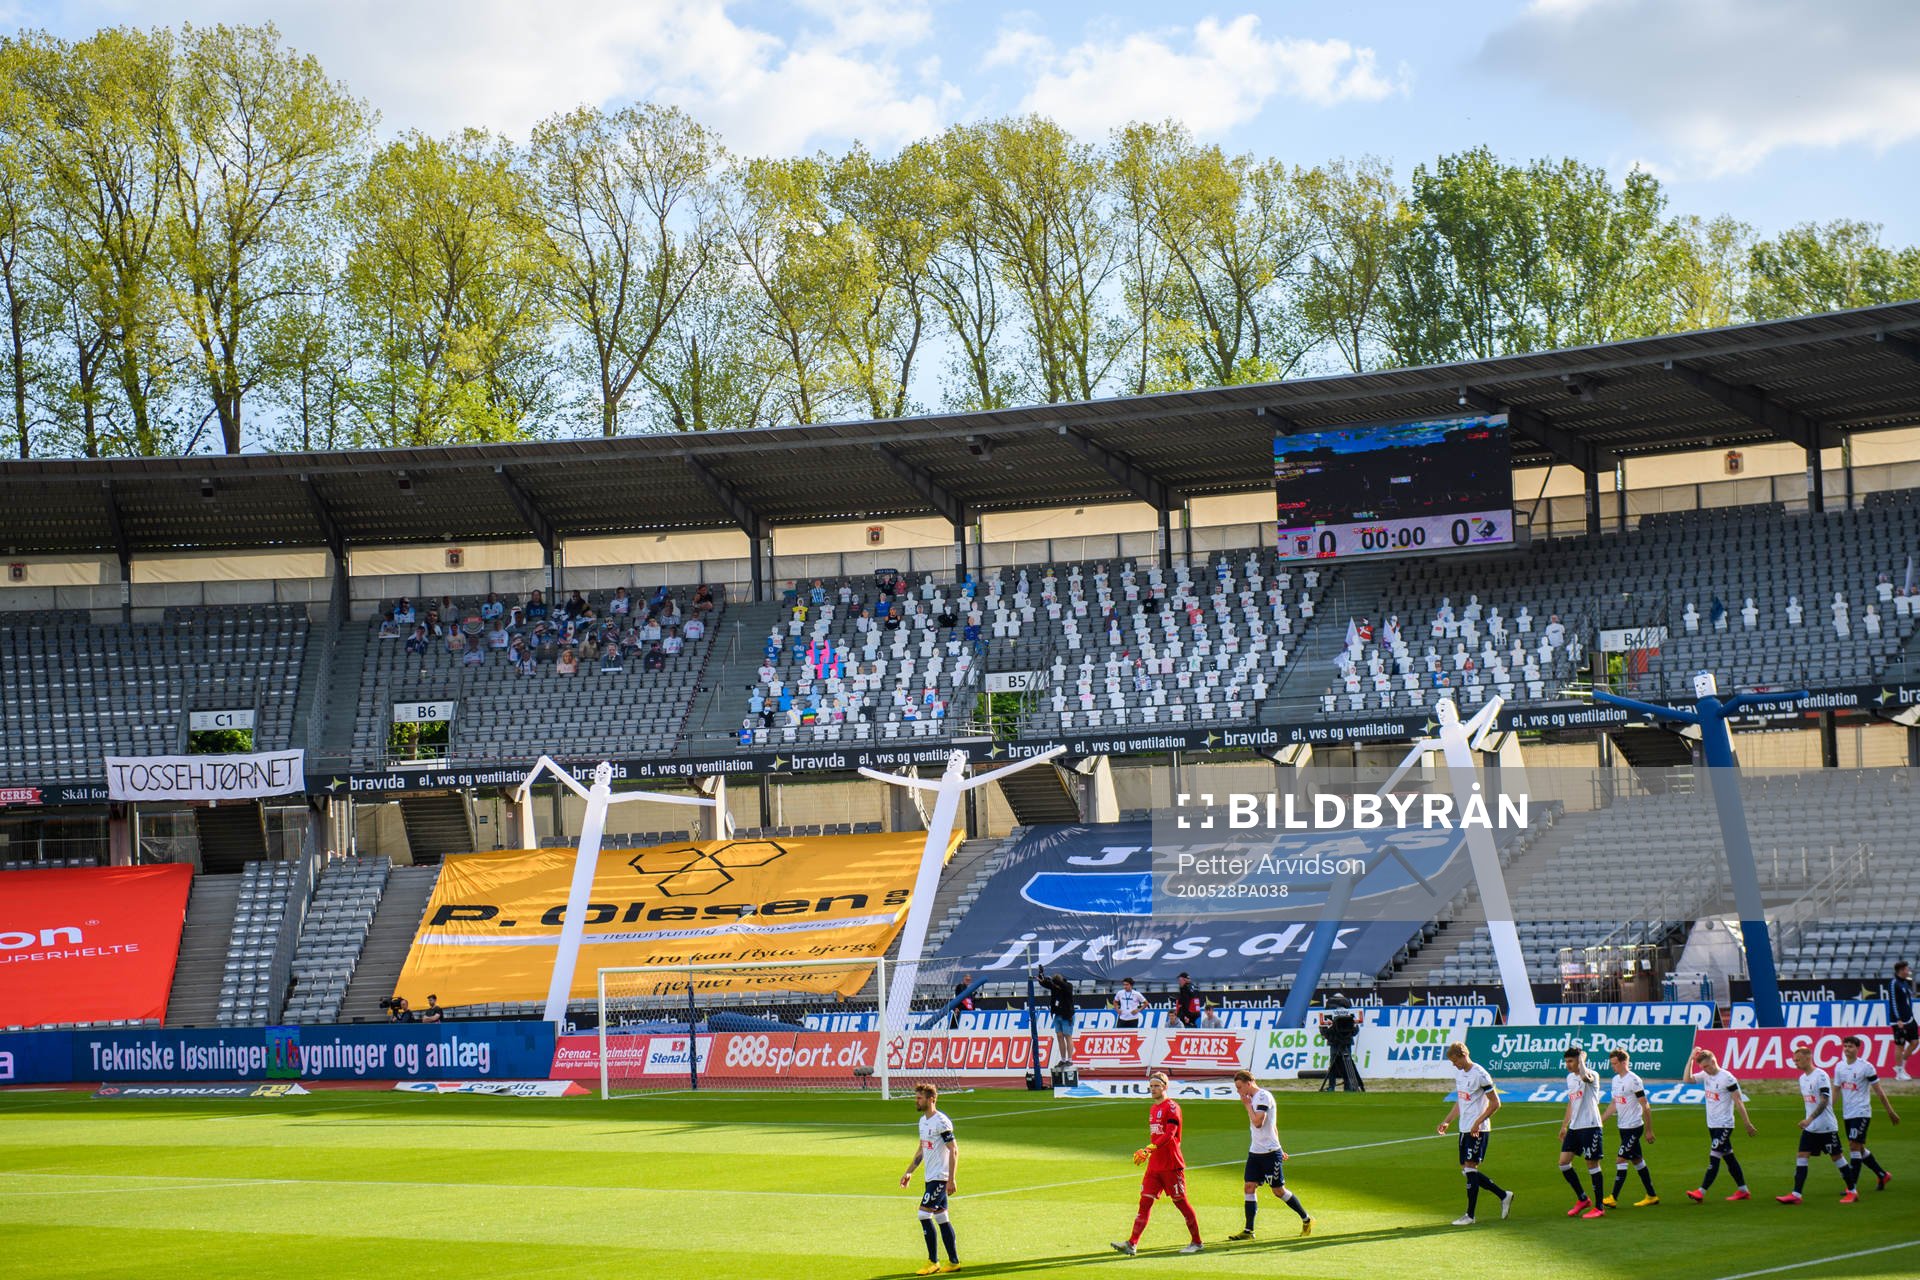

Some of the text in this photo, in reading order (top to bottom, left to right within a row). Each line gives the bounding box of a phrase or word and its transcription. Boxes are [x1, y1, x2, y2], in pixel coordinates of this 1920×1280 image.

[1362, 526, 1426, 550] 00:00
[1452, 519, 1469, 545] 0
[1008, 675, 1026, 688] B5
[1796, 693, 1857, 709] ventilation
[215, 714, 233, 726] C1
[417, 705, 437, 718] B6
[1512, 714, 1527, 728] el,
[1530, 715, 1548, 726] vvs
[1552, 714, 1565, 727] og
[1568, 708, 1627, 723] ventilation
[1224, 728, 1278, 746] bravida
[1291, 722, 1404, 742] el, vvs og ventilation
[1074, 736, 1186, 754] el, vvs og ventilation
[792, 753, 845, 769] bravida
[859, 748, 970, 766] el, vvs og ventilatn
[112, 756, 299, 792] TOSSEHJØRNET
[573, 764, 627, 780] brada
[641, 760, 753, 777] el, vvs og ventilation
[350, 774, 405, 791] bravida
[419, 774, 434, 788] el,
[437, 775, 456, 785] vvs
[459, 775, 472, 787] og
[1, 790, 32, 801] CERES
[62, 788, 108, 800] Skål for
[429, 904, 517, 927] P.
[541, 893, 868, 926] Olesen
[1427, 991, 1486, 1006] bravida
[958, 1013, 1022, 1030] BLUE
[1034, 1011, 1116, 1029] WTER
[1390, 1008, 1493, 1027] WATER
[1597, 1005, 1711, 1029] WATER
[1269, 1030, 1307, 1048] Køb
[1395, 1028, 1450, 1044] SPORT
[557, 1048, 591, 1059] Grenaa
[599, 1046, 645, 1058] almstad
[725, 1034, 868, 1074] 888sport.dk
[909, 1039, 1049, 1064] BAUHAUS
[1084, 1036, 1131, 1055] CERES
[1179, 1037, 1229, 1056] CERES
[1491, 1033, 1664, 1058] Jyllands-Posten
[1722, 1034, 1895, 1069] MASCOT
[90, 1035, 490, 1076] Tekniske løsninger i bygninger og anlæg
[1265, 1052, 1308, 1070] AGF
[1364, 1050, 1371, 1069] i
[1488, 1059, 1502, 1071] Stil
[1598, 1059, 1610, 1070] vil
[1634, 1062, 1662, 1071] mere
[122, 1087, 247, 1095] PROTRUCK
[1467, 1148, 1473, 1160] 5
